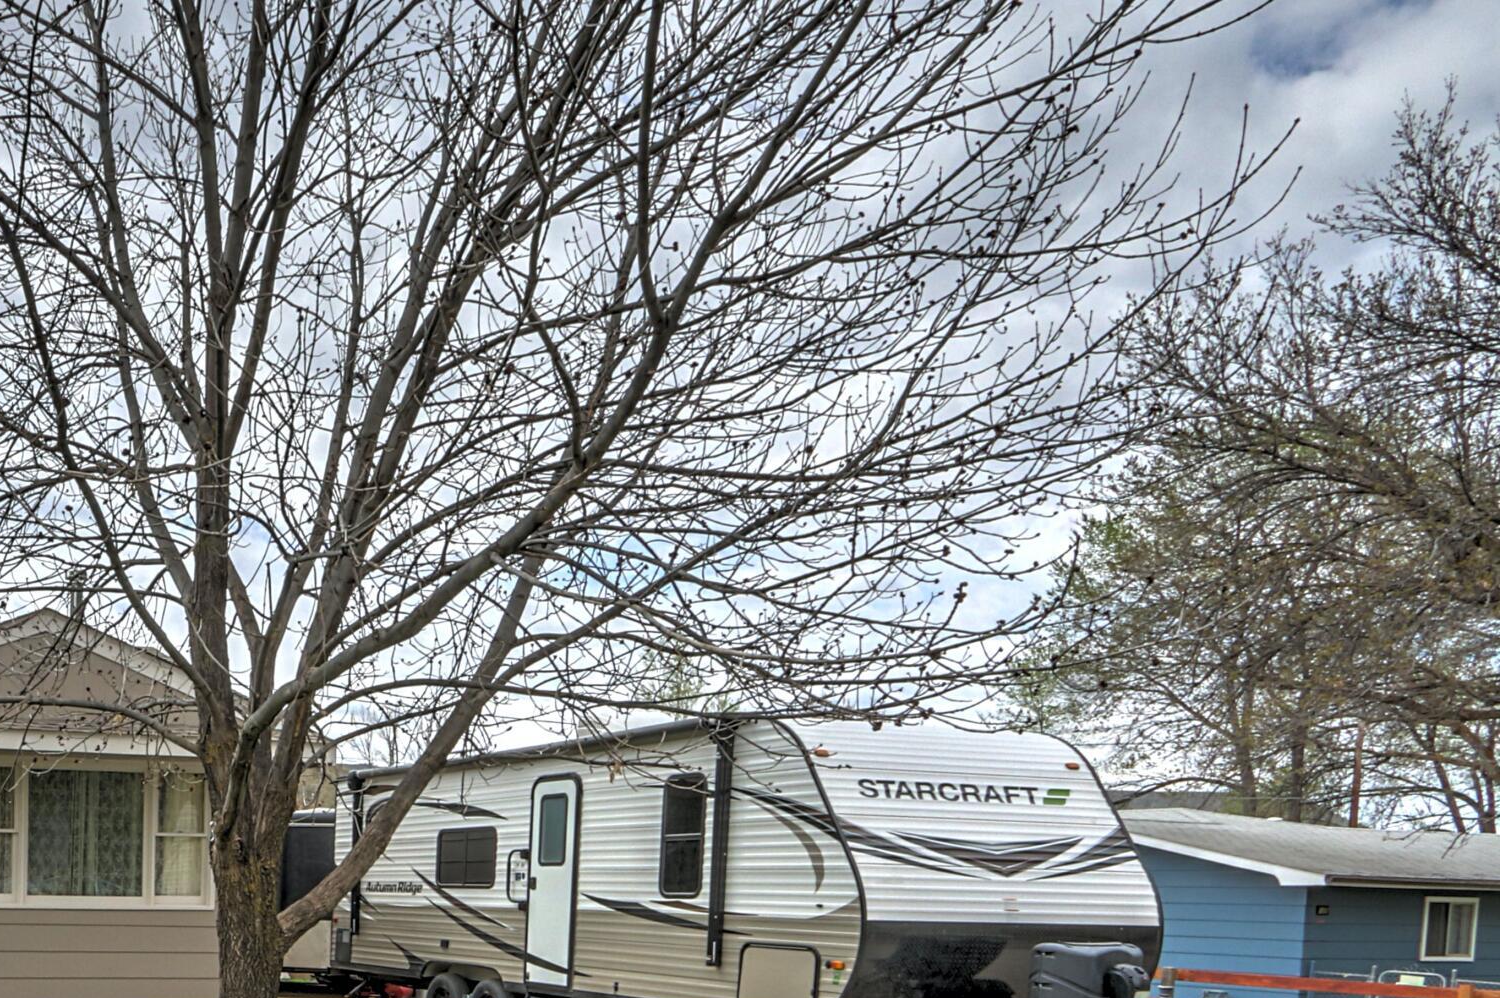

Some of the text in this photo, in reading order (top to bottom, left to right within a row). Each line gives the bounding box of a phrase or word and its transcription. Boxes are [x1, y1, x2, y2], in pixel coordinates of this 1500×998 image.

[857, 779, 1039, 805] STARCRAFT
[365, 881, 423, 896] Autumn Ridge
